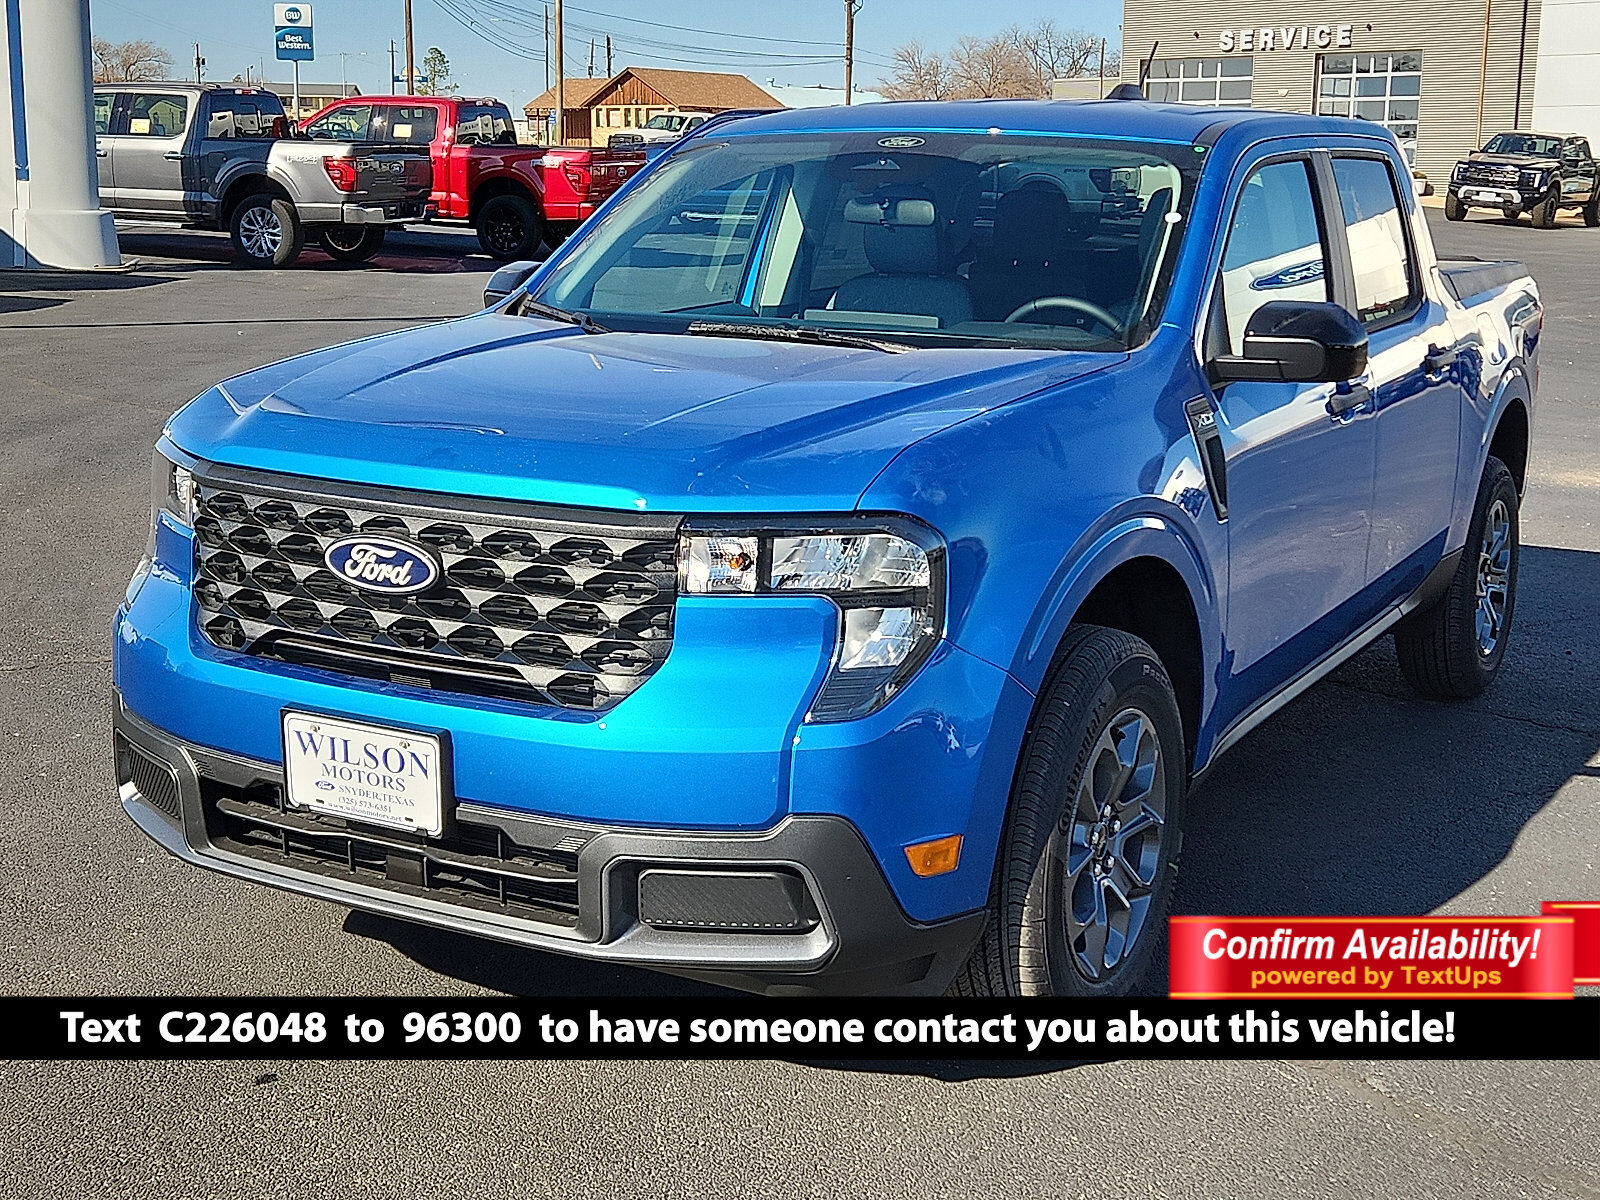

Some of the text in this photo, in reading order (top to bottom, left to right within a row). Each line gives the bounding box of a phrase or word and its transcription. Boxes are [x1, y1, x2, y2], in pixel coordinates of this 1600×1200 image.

[284, 34, 303, 42] Best
[1218, 25, 1352, 52] SERVICE
[344, 544, 414, 586] Ford
[295, 730, 430, 780] WILSON
[321, 763, 406, 792] MOTORS
[338, 796, 392, 813] (325) 573-6351
